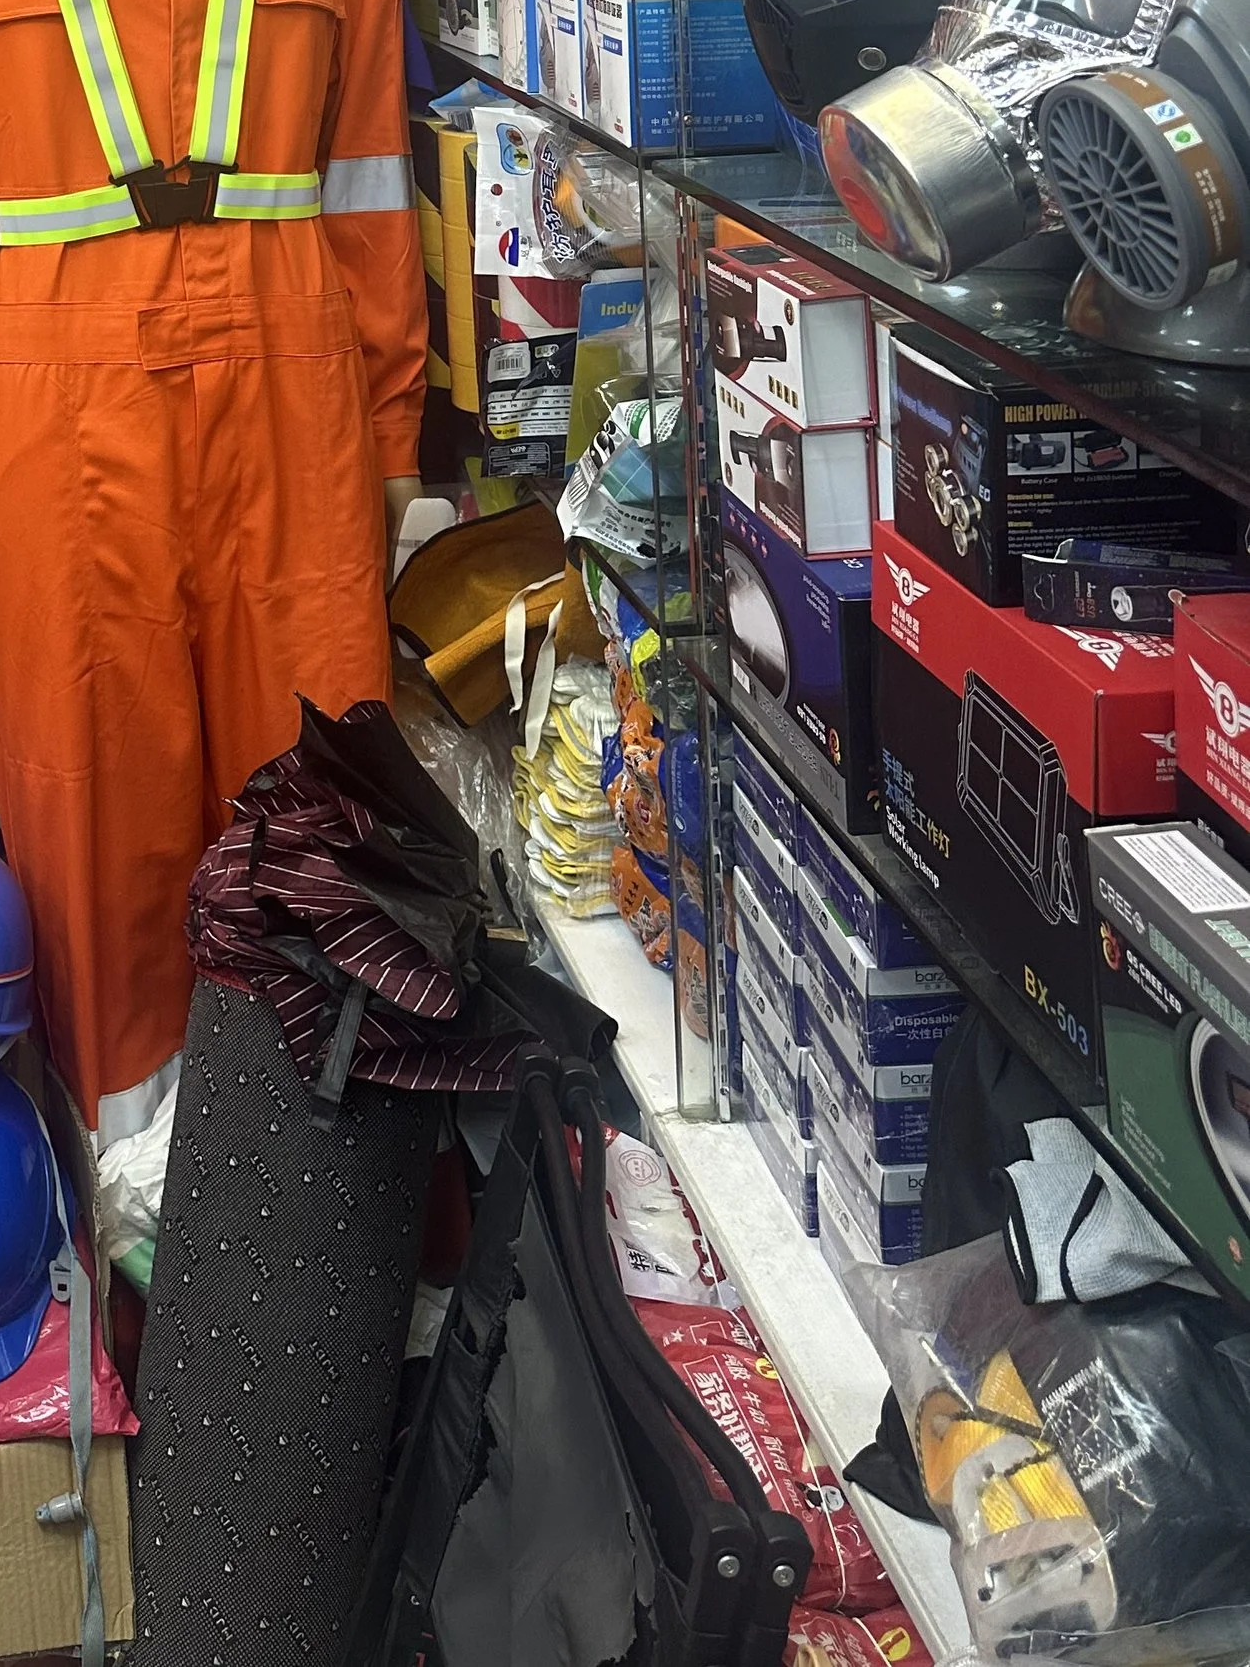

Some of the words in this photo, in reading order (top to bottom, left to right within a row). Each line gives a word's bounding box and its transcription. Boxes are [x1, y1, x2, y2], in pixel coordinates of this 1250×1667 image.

[1004, 405, 1033, 423] HIGH
[885, 805, 907, 833] Solar
[887, 821, 919, 869] Working
[919, 854, 940, 889] lamp
[1099, 877, 1134, 927] CREE
[1024, 964, 1089, 1056] BX-503
[1139, 961, 1163, 996] CREE
[1162, 986, 1183, 1014] LED
